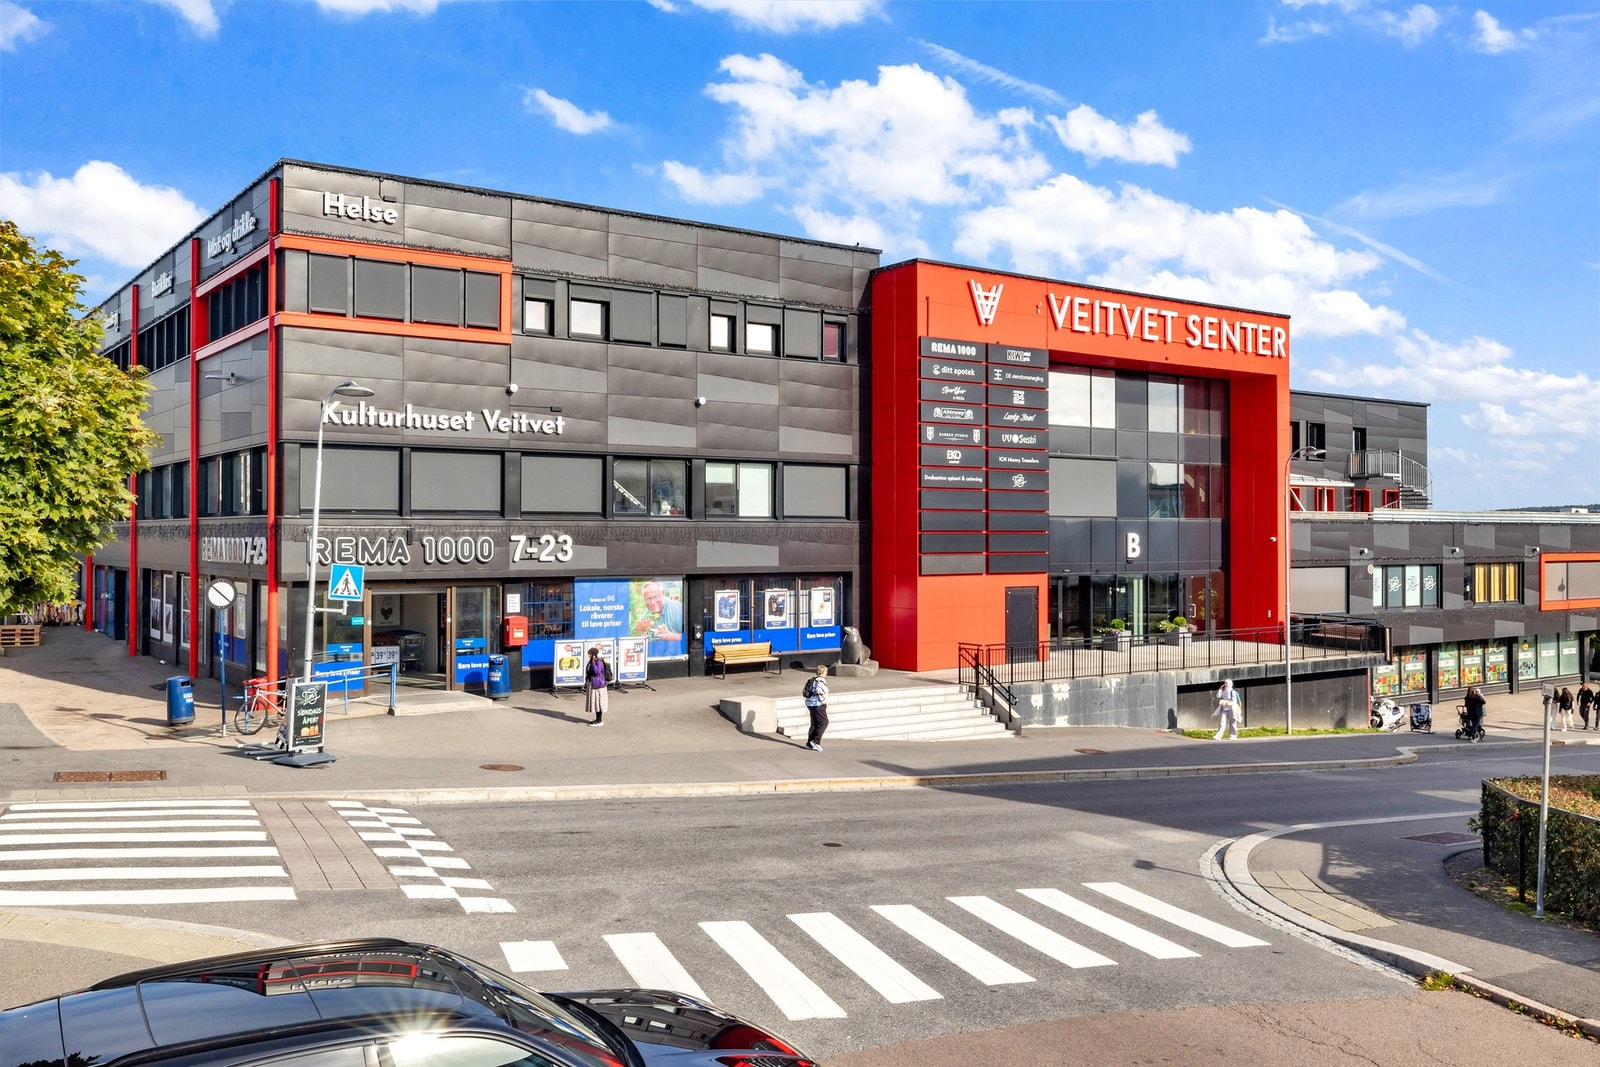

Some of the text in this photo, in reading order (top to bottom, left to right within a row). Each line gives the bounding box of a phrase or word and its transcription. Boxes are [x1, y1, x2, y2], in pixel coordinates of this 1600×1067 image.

[322, 191, 398, 225] Helse
[231, 211, 256, 243] drikke
[1047, 292, 1287, 358] VEITVET SENTER
[931, 341, 977, 357] REMA 1000
[941, 364, 976, 377] ditt apotek
[322, 400, 566, 435] Kulturhuset Veitvet
[1018, 434, 1037, 444] Sushi
[244, 536, 268, 565] 7-23
[309, 534, 574, 565] REMA 1000 7-23
[1126, 532, 1141, 559] B
[579, 604, 603, 612] Lokale,
[590, 612, 614, 620] råvarer
[581, 620, 589, 628] til
[603, 619, 622, 628] priser
[302, 715, 319, 725] ÅPENT
